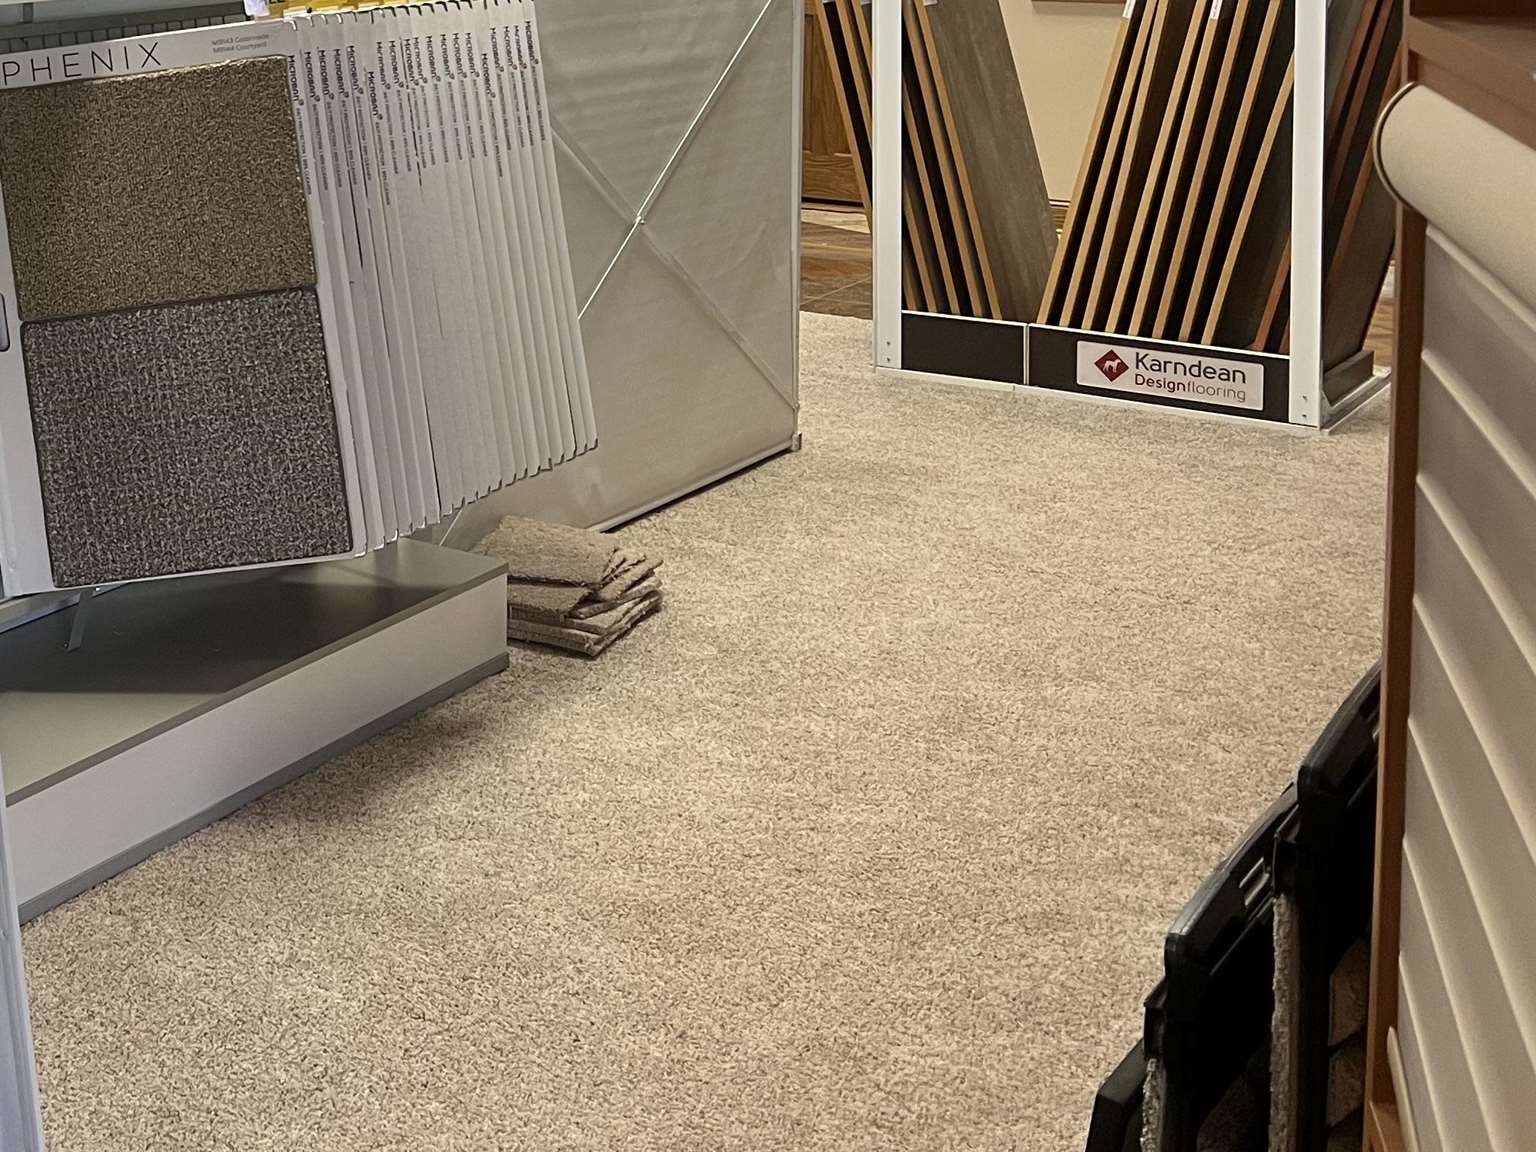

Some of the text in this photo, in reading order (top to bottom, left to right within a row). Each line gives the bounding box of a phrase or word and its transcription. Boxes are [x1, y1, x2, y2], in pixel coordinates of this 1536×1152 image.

[1, 41, 162, 86] PHENIX
[1135, 351, 1247, 385] Karndean
[1134, 373, 1247, 404] Designflooring
